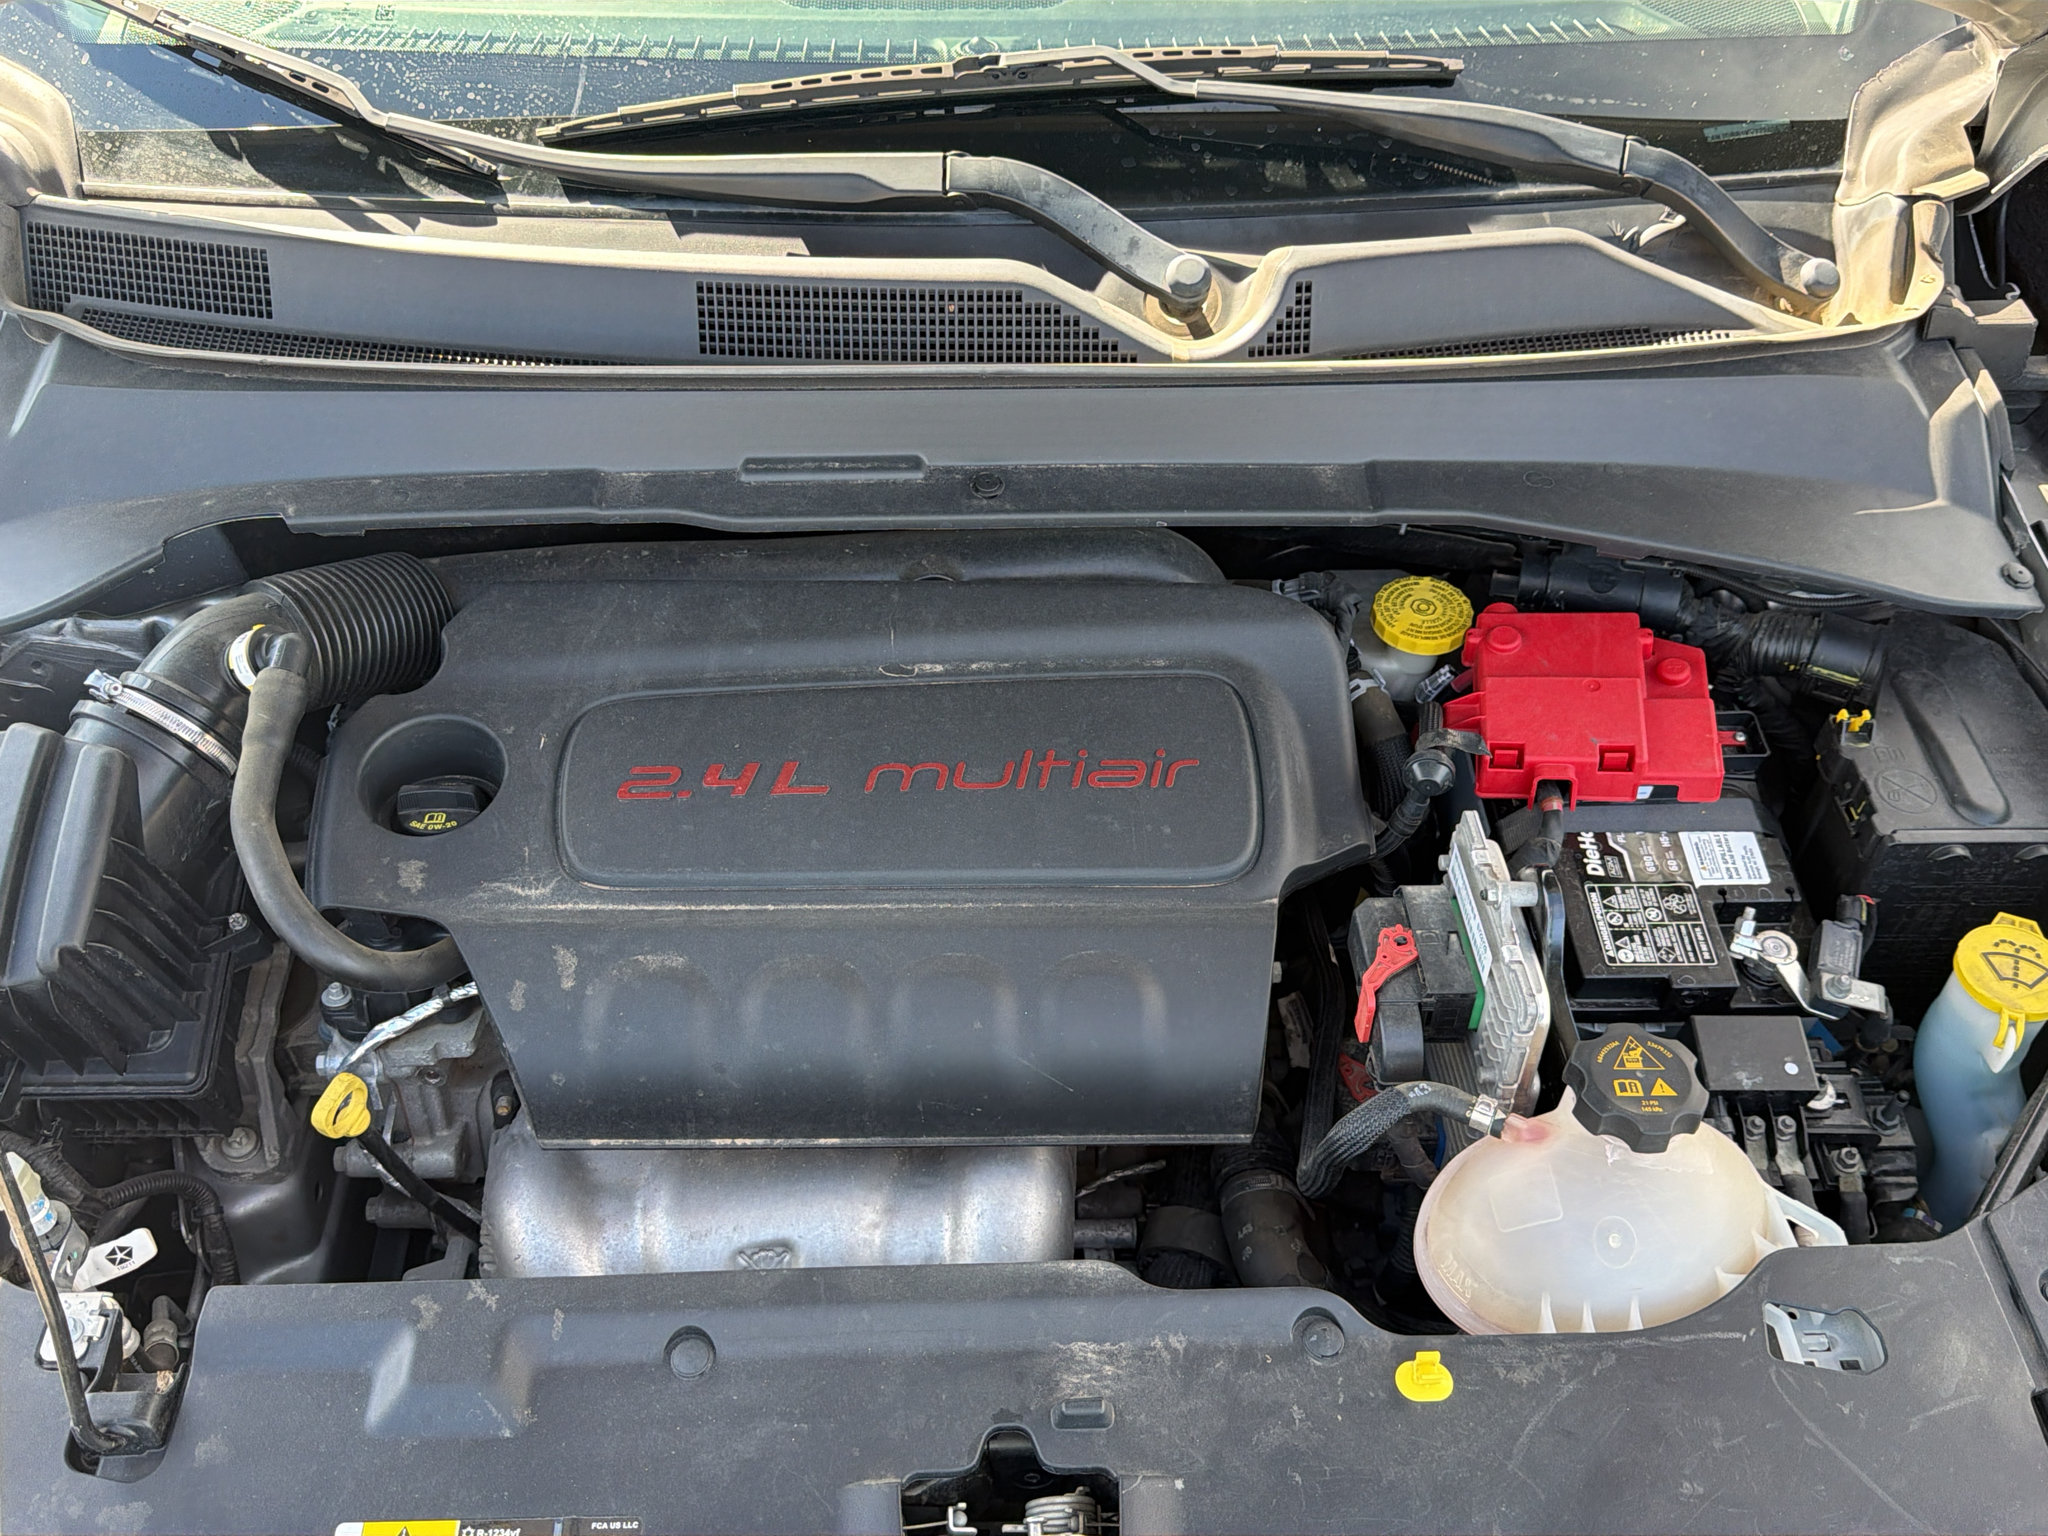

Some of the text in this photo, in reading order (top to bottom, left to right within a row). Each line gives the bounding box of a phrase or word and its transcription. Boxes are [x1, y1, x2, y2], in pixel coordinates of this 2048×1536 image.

[863, 748, 1200, 794] multiair
[409, 820, 458, 831] SAE 0W-20
[1589, 892, 1612, 949] DANGER/POISON
[591, 1521, 639, 1530] FCA US LLC
